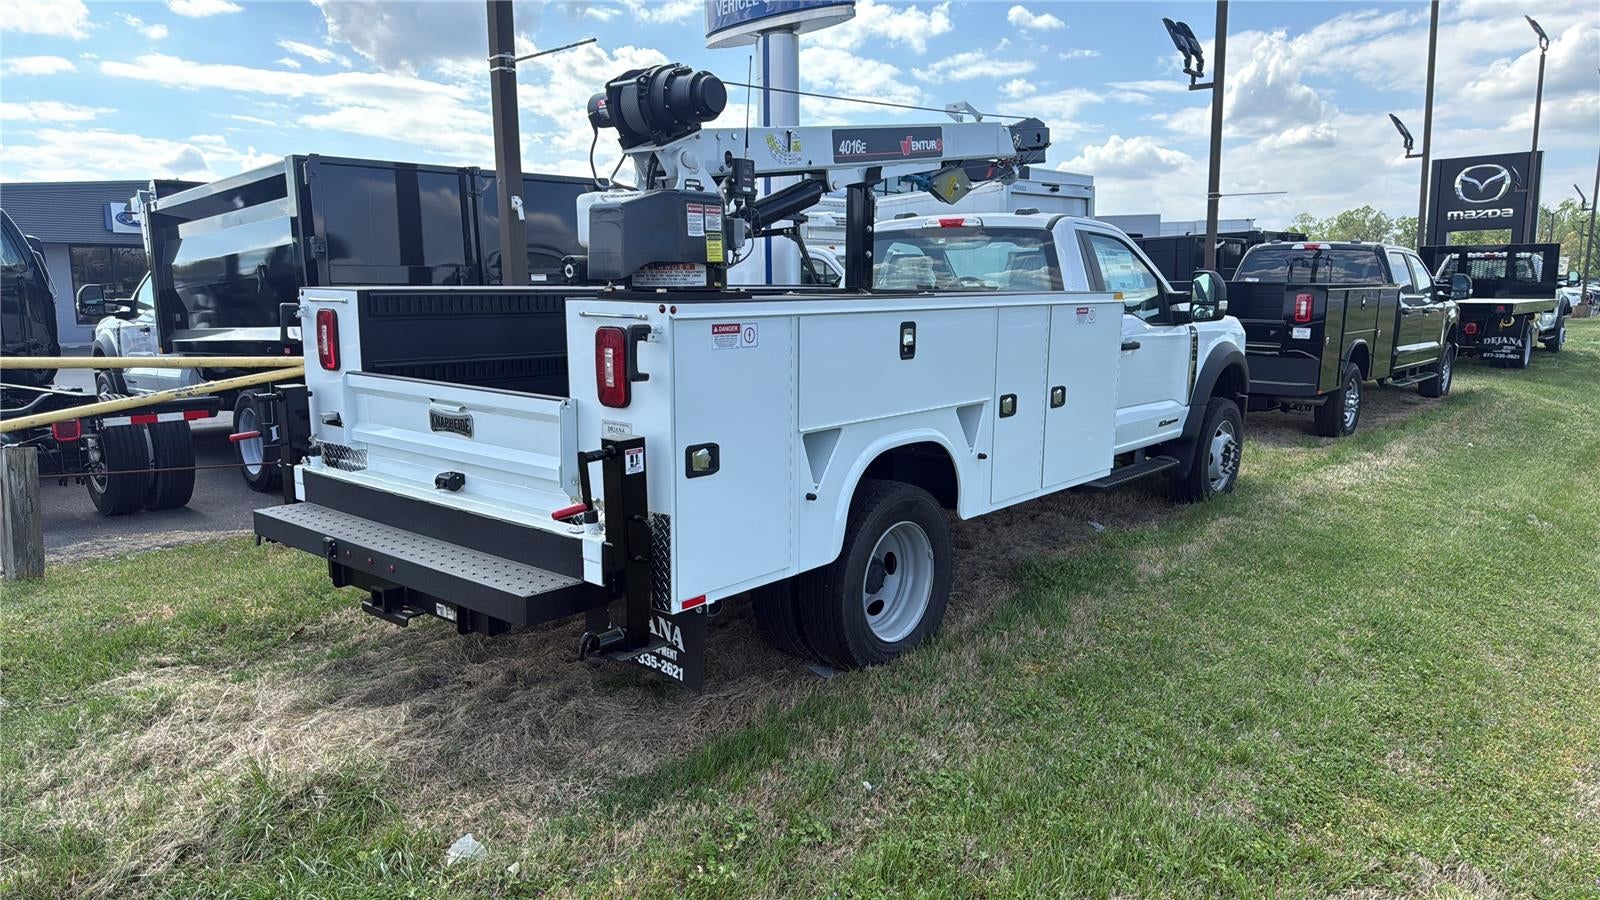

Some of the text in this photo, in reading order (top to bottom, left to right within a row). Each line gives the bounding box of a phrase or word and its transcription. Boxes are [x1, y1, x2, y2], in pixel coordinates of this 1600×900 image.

[838, 139, 867, 155] 4016E
[899, 135, 943, 156] VENTURO
[1483, 336, 1523, 347] DEJANA
[430, 412, 472, 433] KNAPHEIDE
[649, 616, 686, 653] ANA
[634, 653, 684, 682] -335-2621
